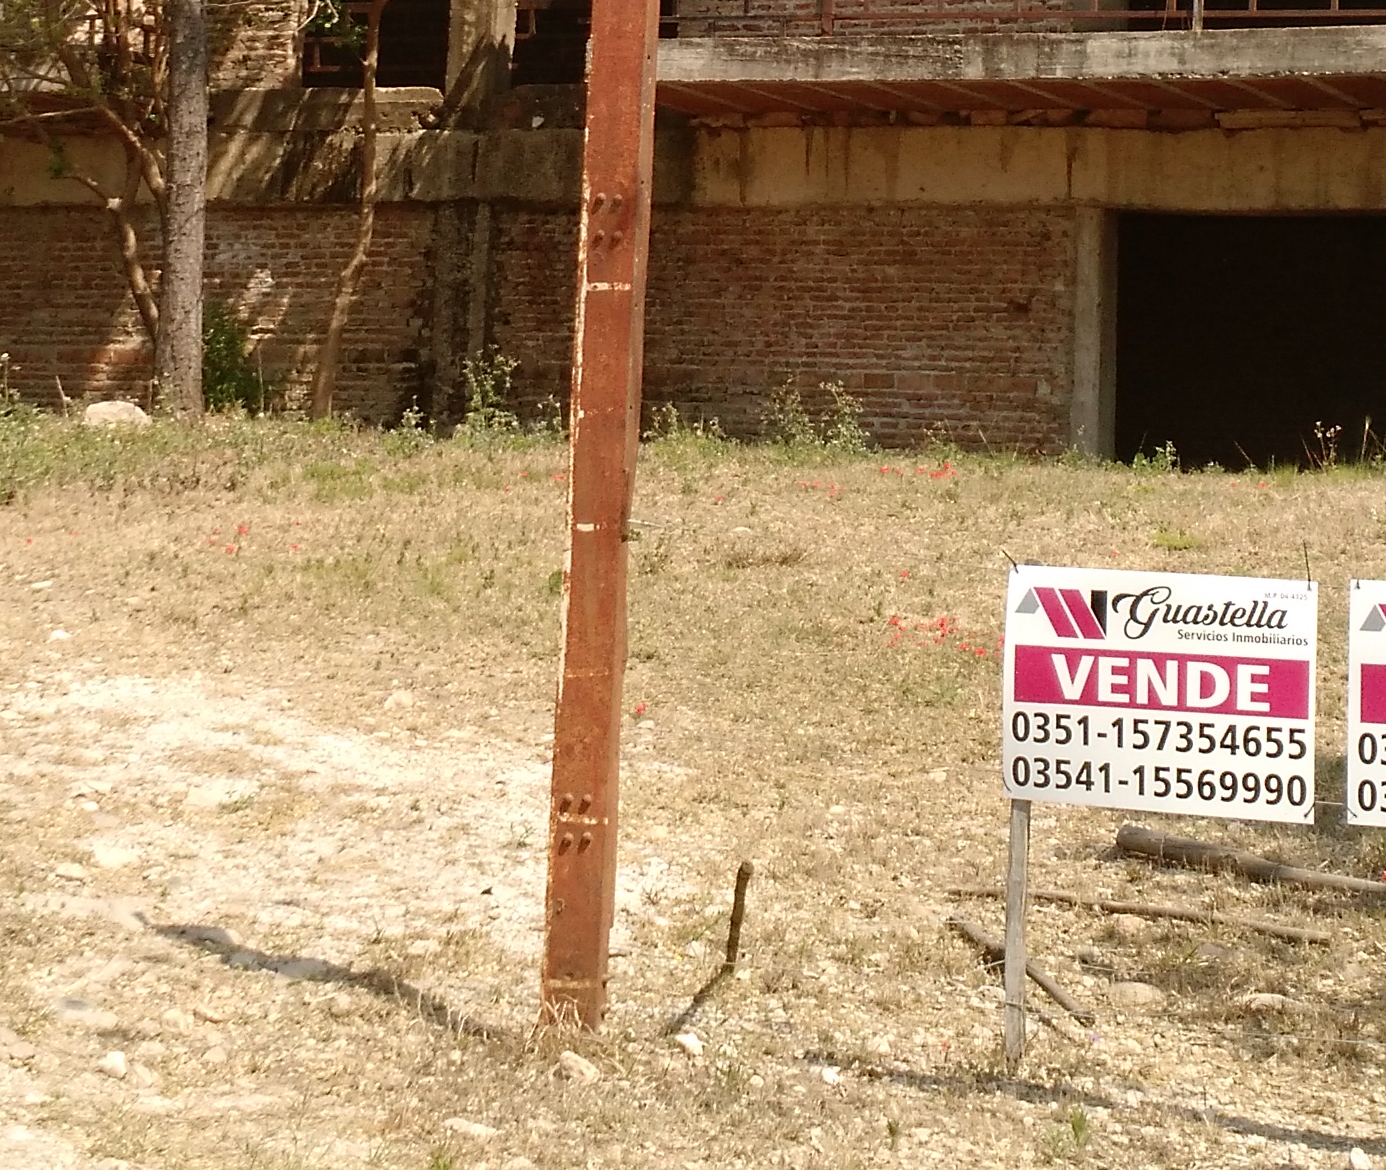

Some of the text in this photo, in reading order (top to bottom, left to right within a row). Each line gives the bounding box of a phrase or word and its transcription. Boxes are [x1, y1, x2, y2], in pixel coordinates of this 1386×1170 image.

[1112, 586, 1288, 639] Guastella
[1177, 629, 1309, 646] Servicios Inmobiliarios
[1051, 653, 1271, 713] VENDE
[1012, 711, 1307, 760] 0351-157354655
[1012, 756, 1307, 807] 03541-15569990
